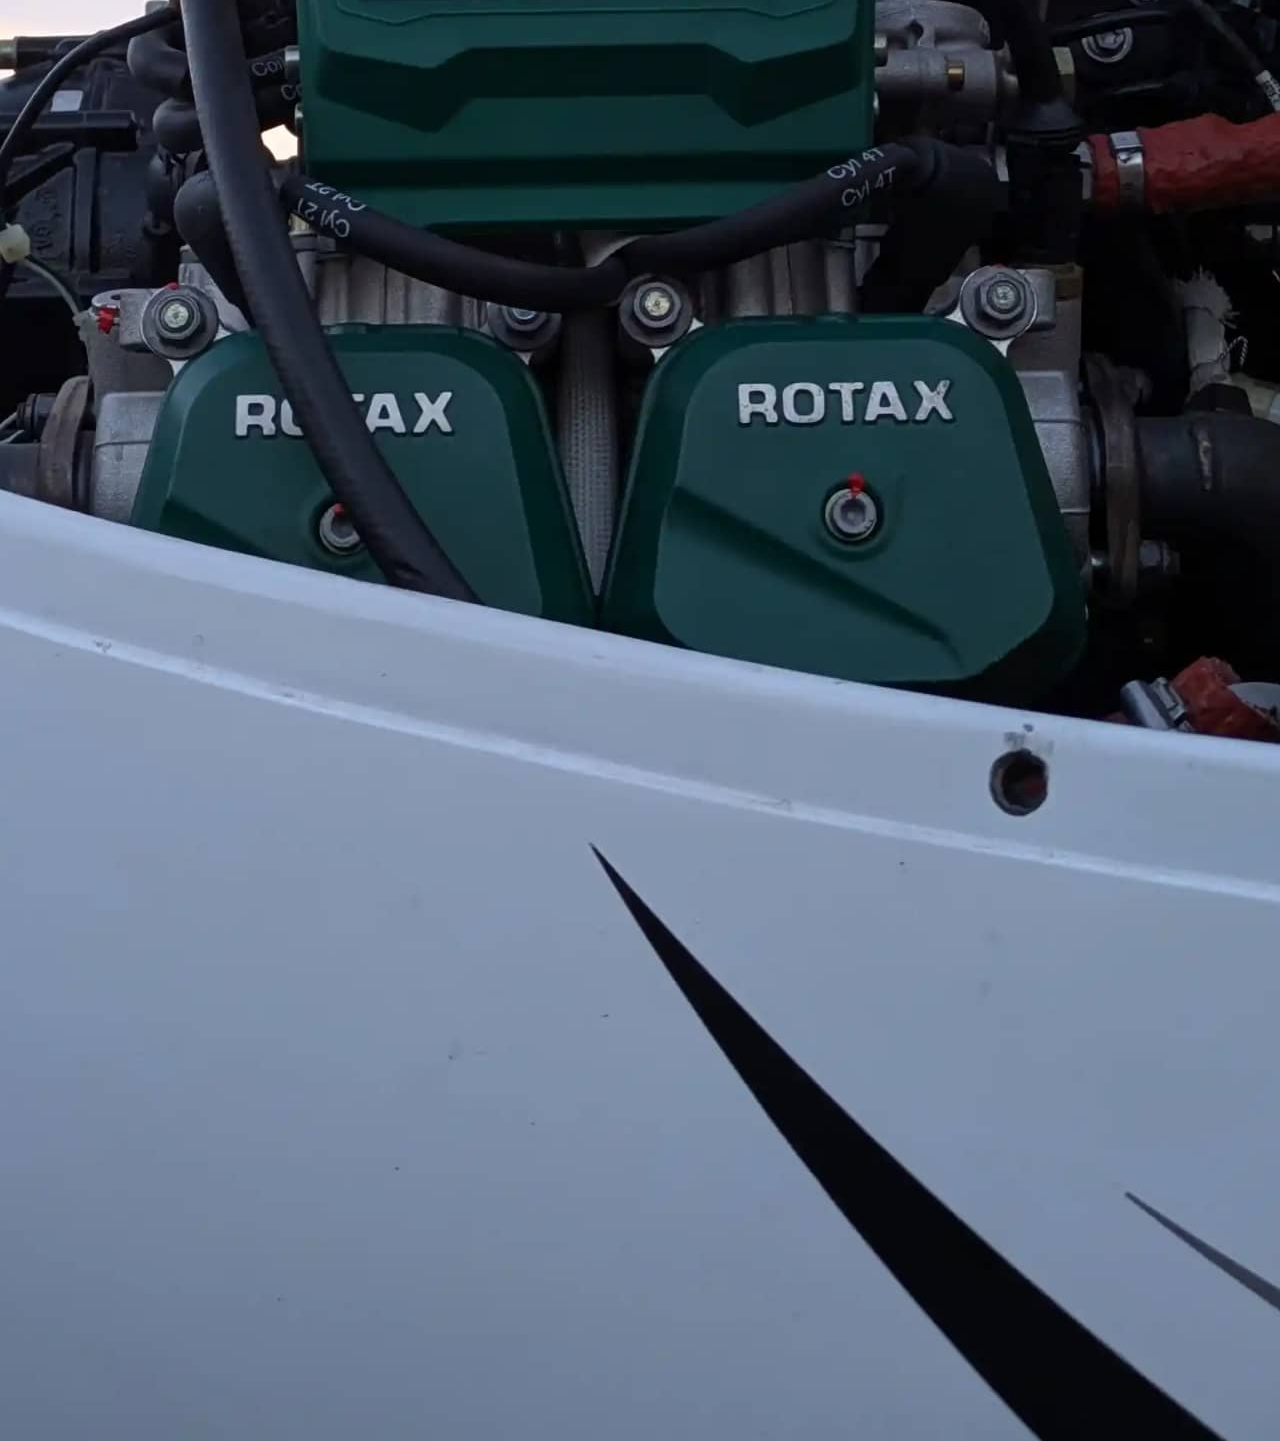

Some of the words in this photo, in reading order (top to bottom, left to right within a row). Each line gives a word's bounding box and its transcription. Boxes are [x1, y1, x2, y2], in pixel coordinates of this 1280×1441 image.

[827, 158, 862, 179] Cyl
[234, 391, 454, 437] RAX
[738, 379, 955, 425] ROTAX
